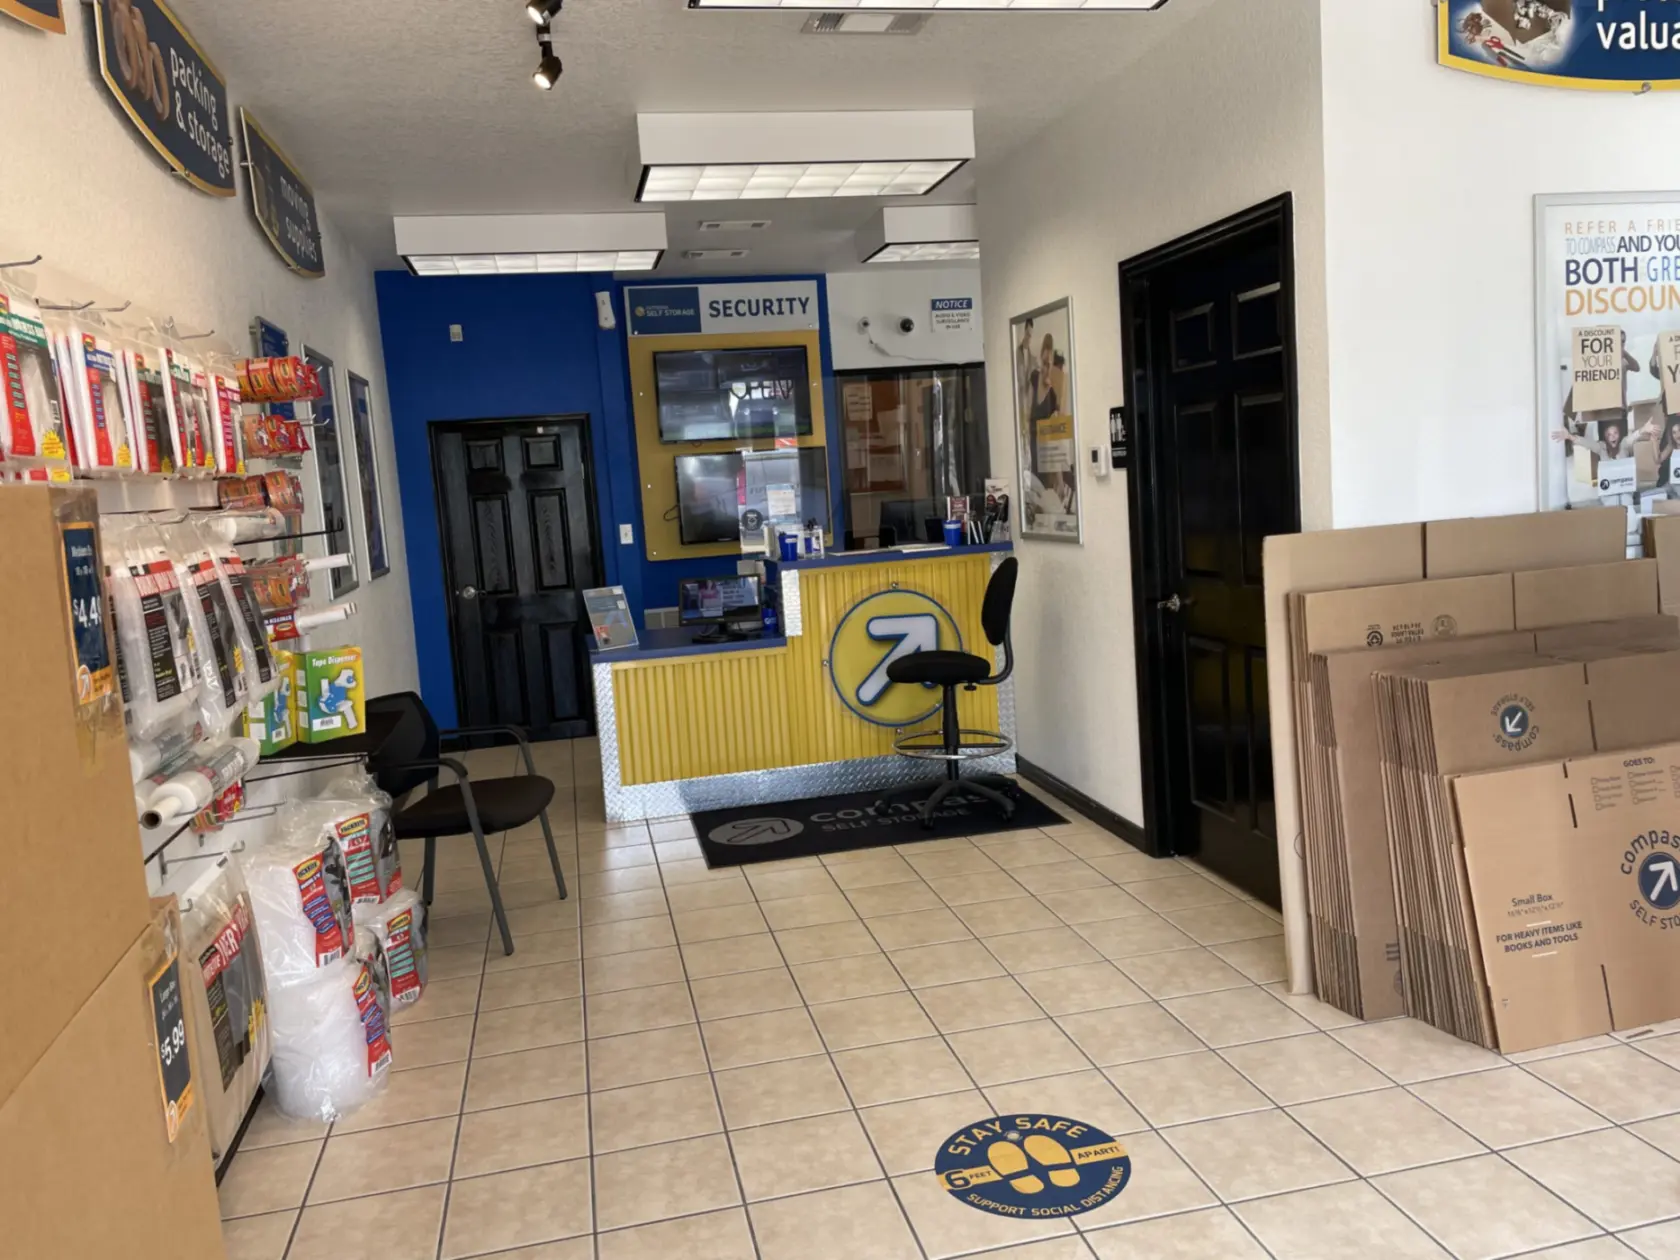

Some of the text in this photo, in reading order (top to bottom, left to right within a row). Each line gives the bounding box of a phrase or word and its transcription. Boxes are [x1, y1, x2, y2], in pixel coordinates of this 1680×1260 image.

[170, 47, 219, 131] packing
[175, 90, 230, 179] & storage
[280, 175, 311, 232] moving
[1564, 220, 1617, 235] REFER
[1627, 219, 1636, 232] A
[285, 216, 317, 262] supplies
[1565, 237, 1576, 255] TO
[1578, 235, 1616, 255] COMPASS
[1616, 236, 1652, 253] AND
[1565, 256, 1638, 286] BOTH
[646, 308, 695, 317] SELF STORAGE
[708, 297, 810, 318] SECURITY
[935, 300, 969, 309] NOTICE
[1584, 328, 1615, 336] DISCOUNT
[1581, 338, 1614, 354] FOR
[1582, 355, 1612, 368] YOUR
[1574, 368, 1620, 382] FRIEND!
[312, 654, 358, 667] Tape Dispenser
[1623, 758, 1643, 768] GOES
[821, 818, 869, 833] SELF
[1511, 893, 1553, 907] Small Box
[1629, 899, 1658, 927] SELF
[1496, 920, 1583, 943] FOR HEAVY ITEMS LIKE
[1503, 932, 1578, 953] BOOKS AND TOOLS
[160, 1019, 184, 1066] $5.99
[948, 1117, 1088, 1156] STAY SAFE
[945, 1146, 1120, 1189] 6 FEET APART!
[966, 1166, 1124, 1216] SUPPORT SOCIAL DISTANCING
